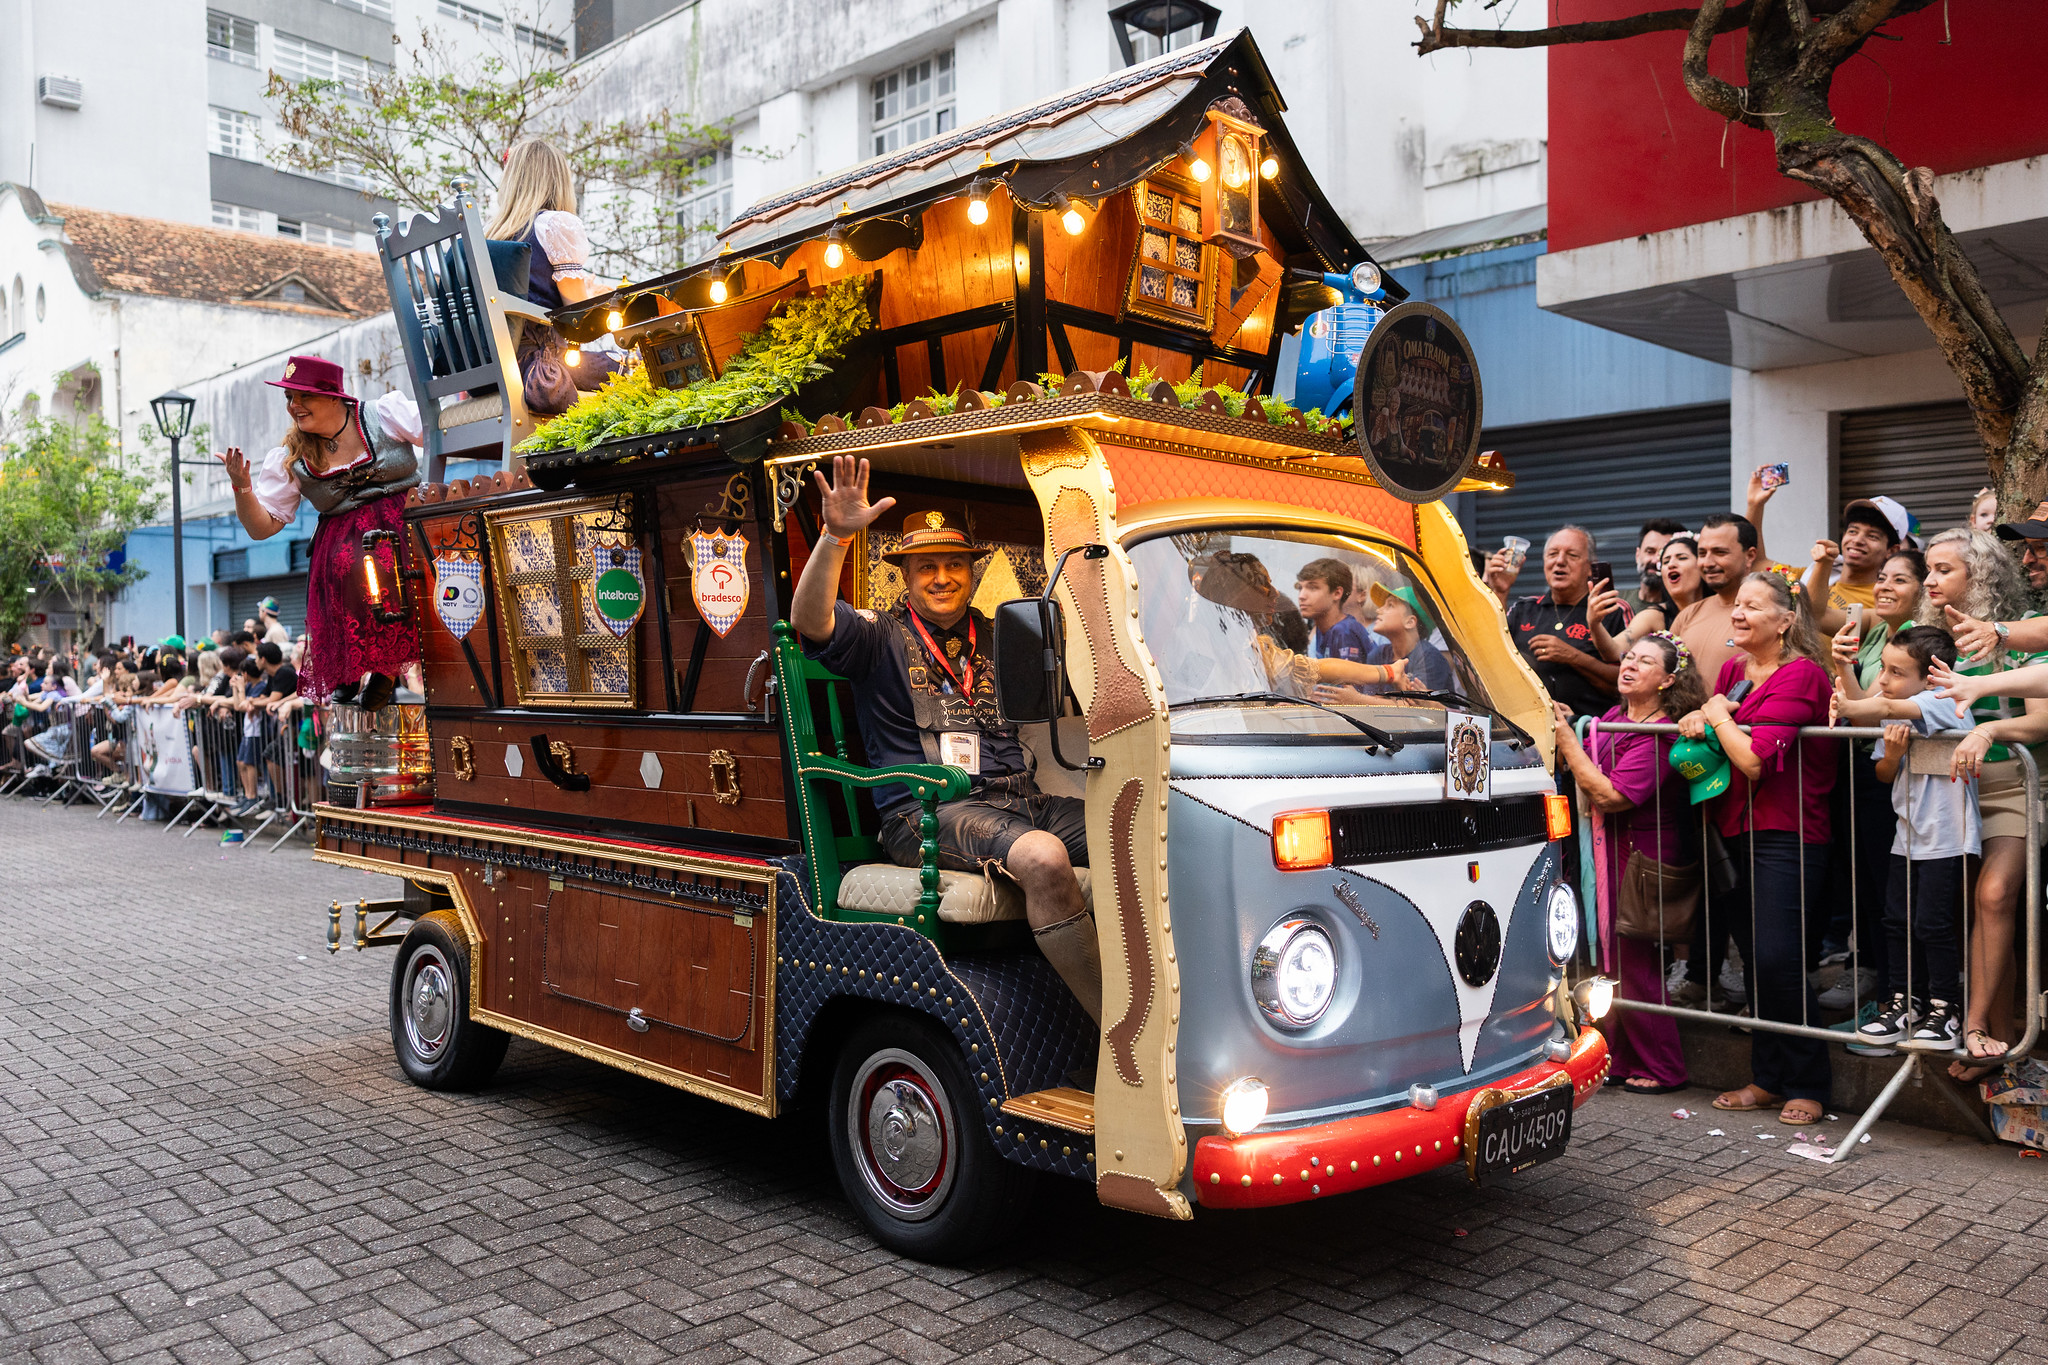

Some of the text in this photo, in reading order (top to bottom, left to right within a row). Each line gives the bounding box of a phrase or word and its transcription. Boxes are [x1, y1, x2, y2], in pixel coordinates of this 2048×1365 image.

[1403, 340, 1423, 359] OMA
[1423, 341, 1450, 373] TRAUM
[598, 589, 639, 601] intelbras
[701, 592, 742, 603] bradesco
